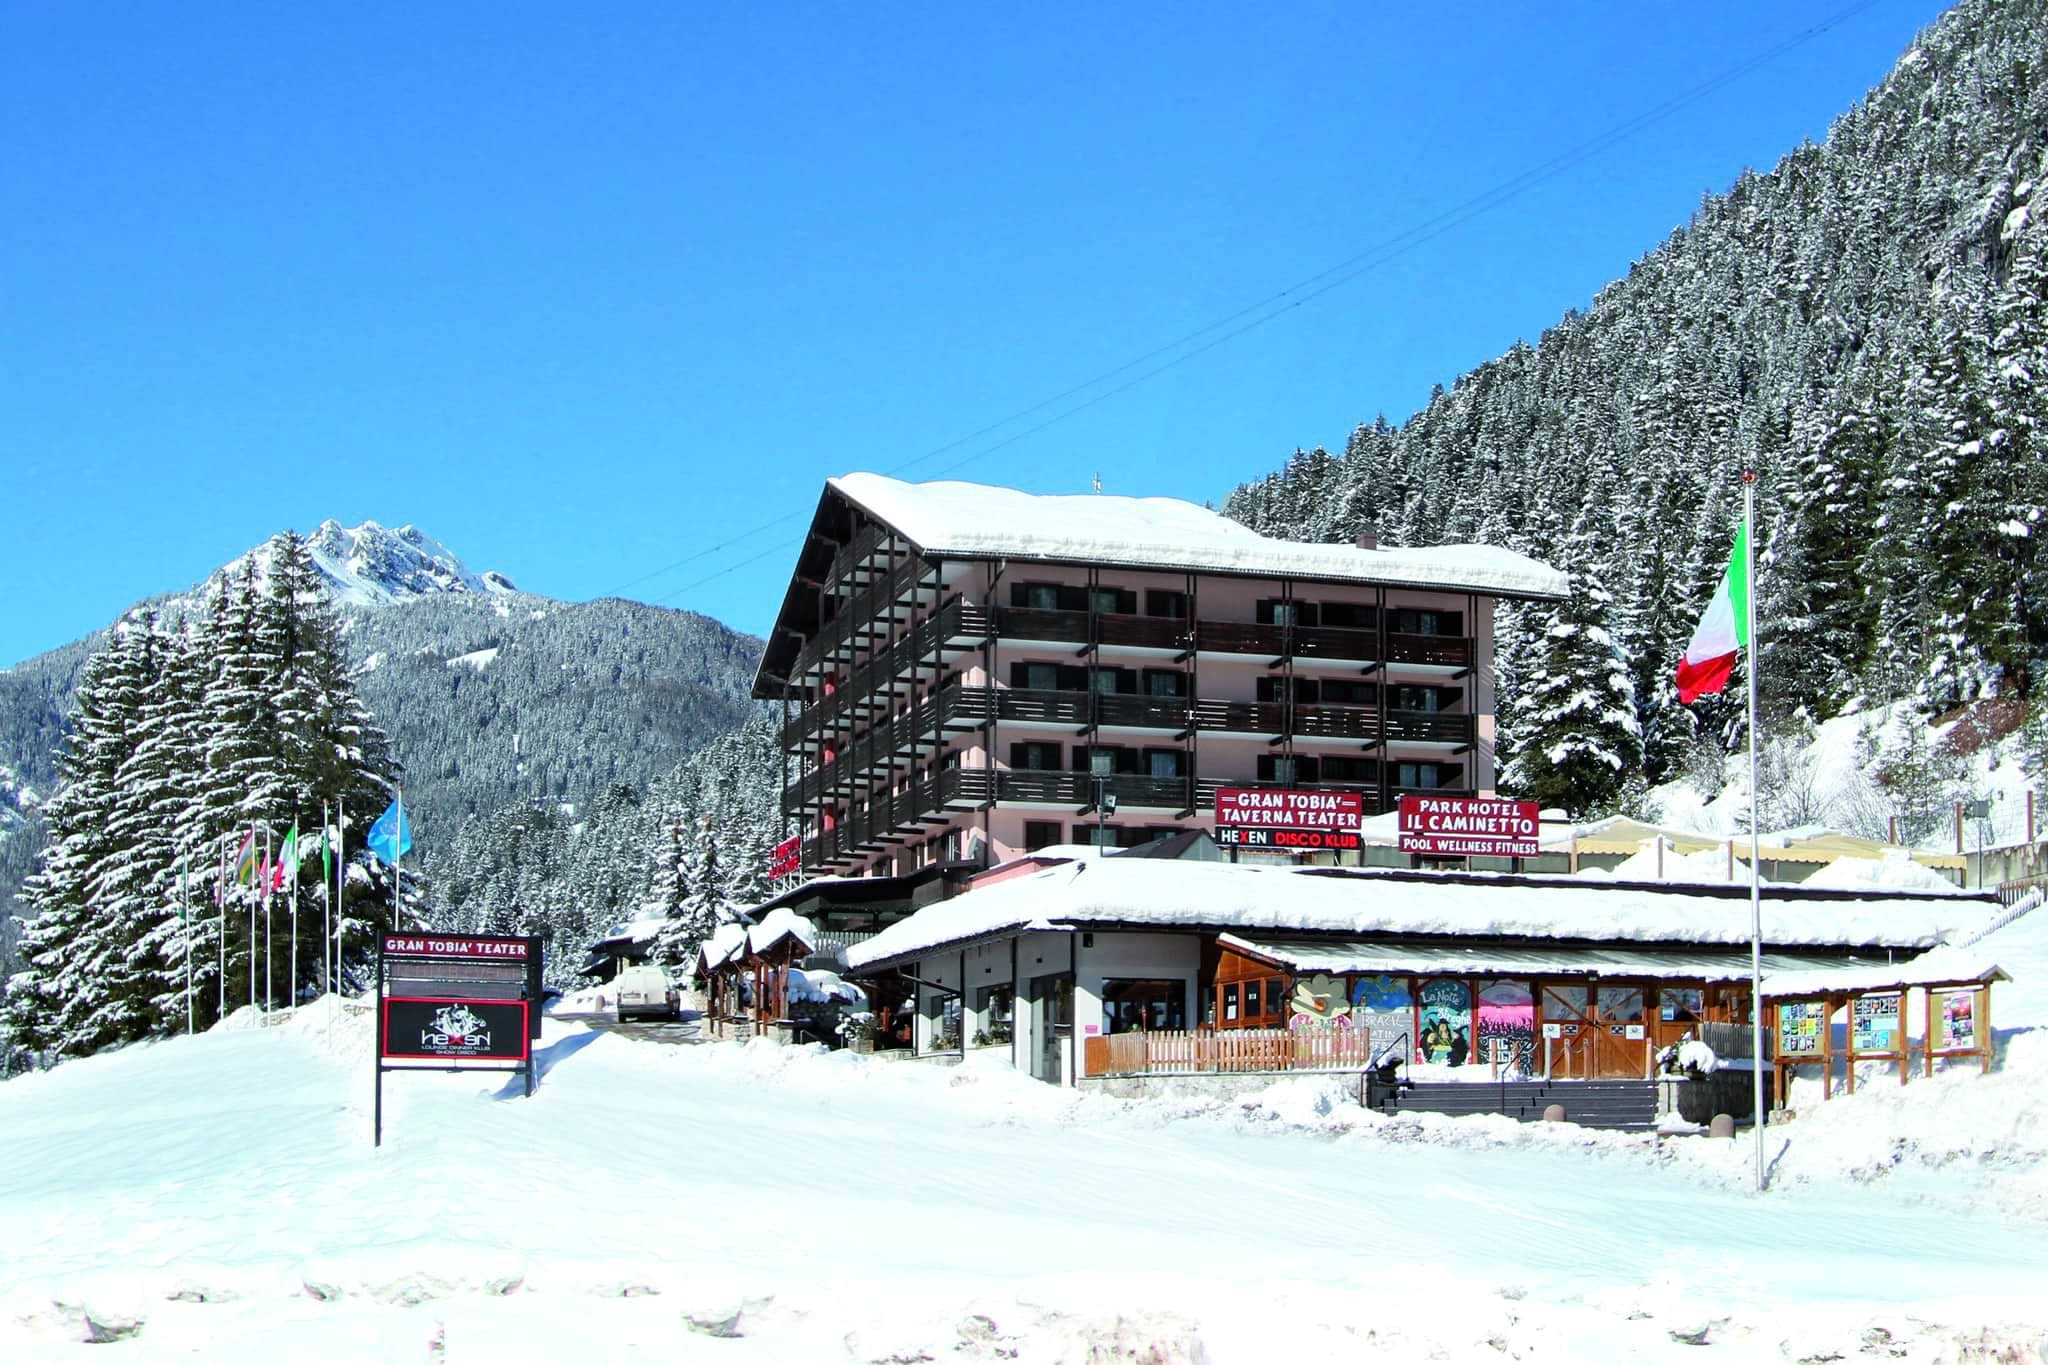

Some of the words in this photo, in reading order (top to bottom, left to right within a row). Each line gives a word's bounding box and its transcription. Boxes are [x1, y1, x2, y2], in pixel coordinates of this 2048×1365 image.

[1237, 793, 1284, 807] GRAN
[1288, 794, 1342, 810] TOBIA'
[1420, 800, 1463, 814] PARK
[1468, 802, 1521, 816] HOTEL
[1222, 808, 1294, 824] TAVERNA
[1298, 811, 1357, 826] TEATER
[1407, 814, 1424, 829] IL
[1428, 815, 1533, 833] CAMINETTO
[1221, 830, 1267, 844] HEXEN
[1275, 832, 1321, 846] DISCO
[1325, 834, 1358, 848] KLUB
[1403, 838, 1433, 850] POOL
[1437, 840, 1493, 852] WELLNESS
[1496, 842, 1537, 854] FITNESS
[386, 939, 424, 951] GRAN
[428, 941, 473, 953] TOBIA'
[476, 943, 527, 955] TEATER
